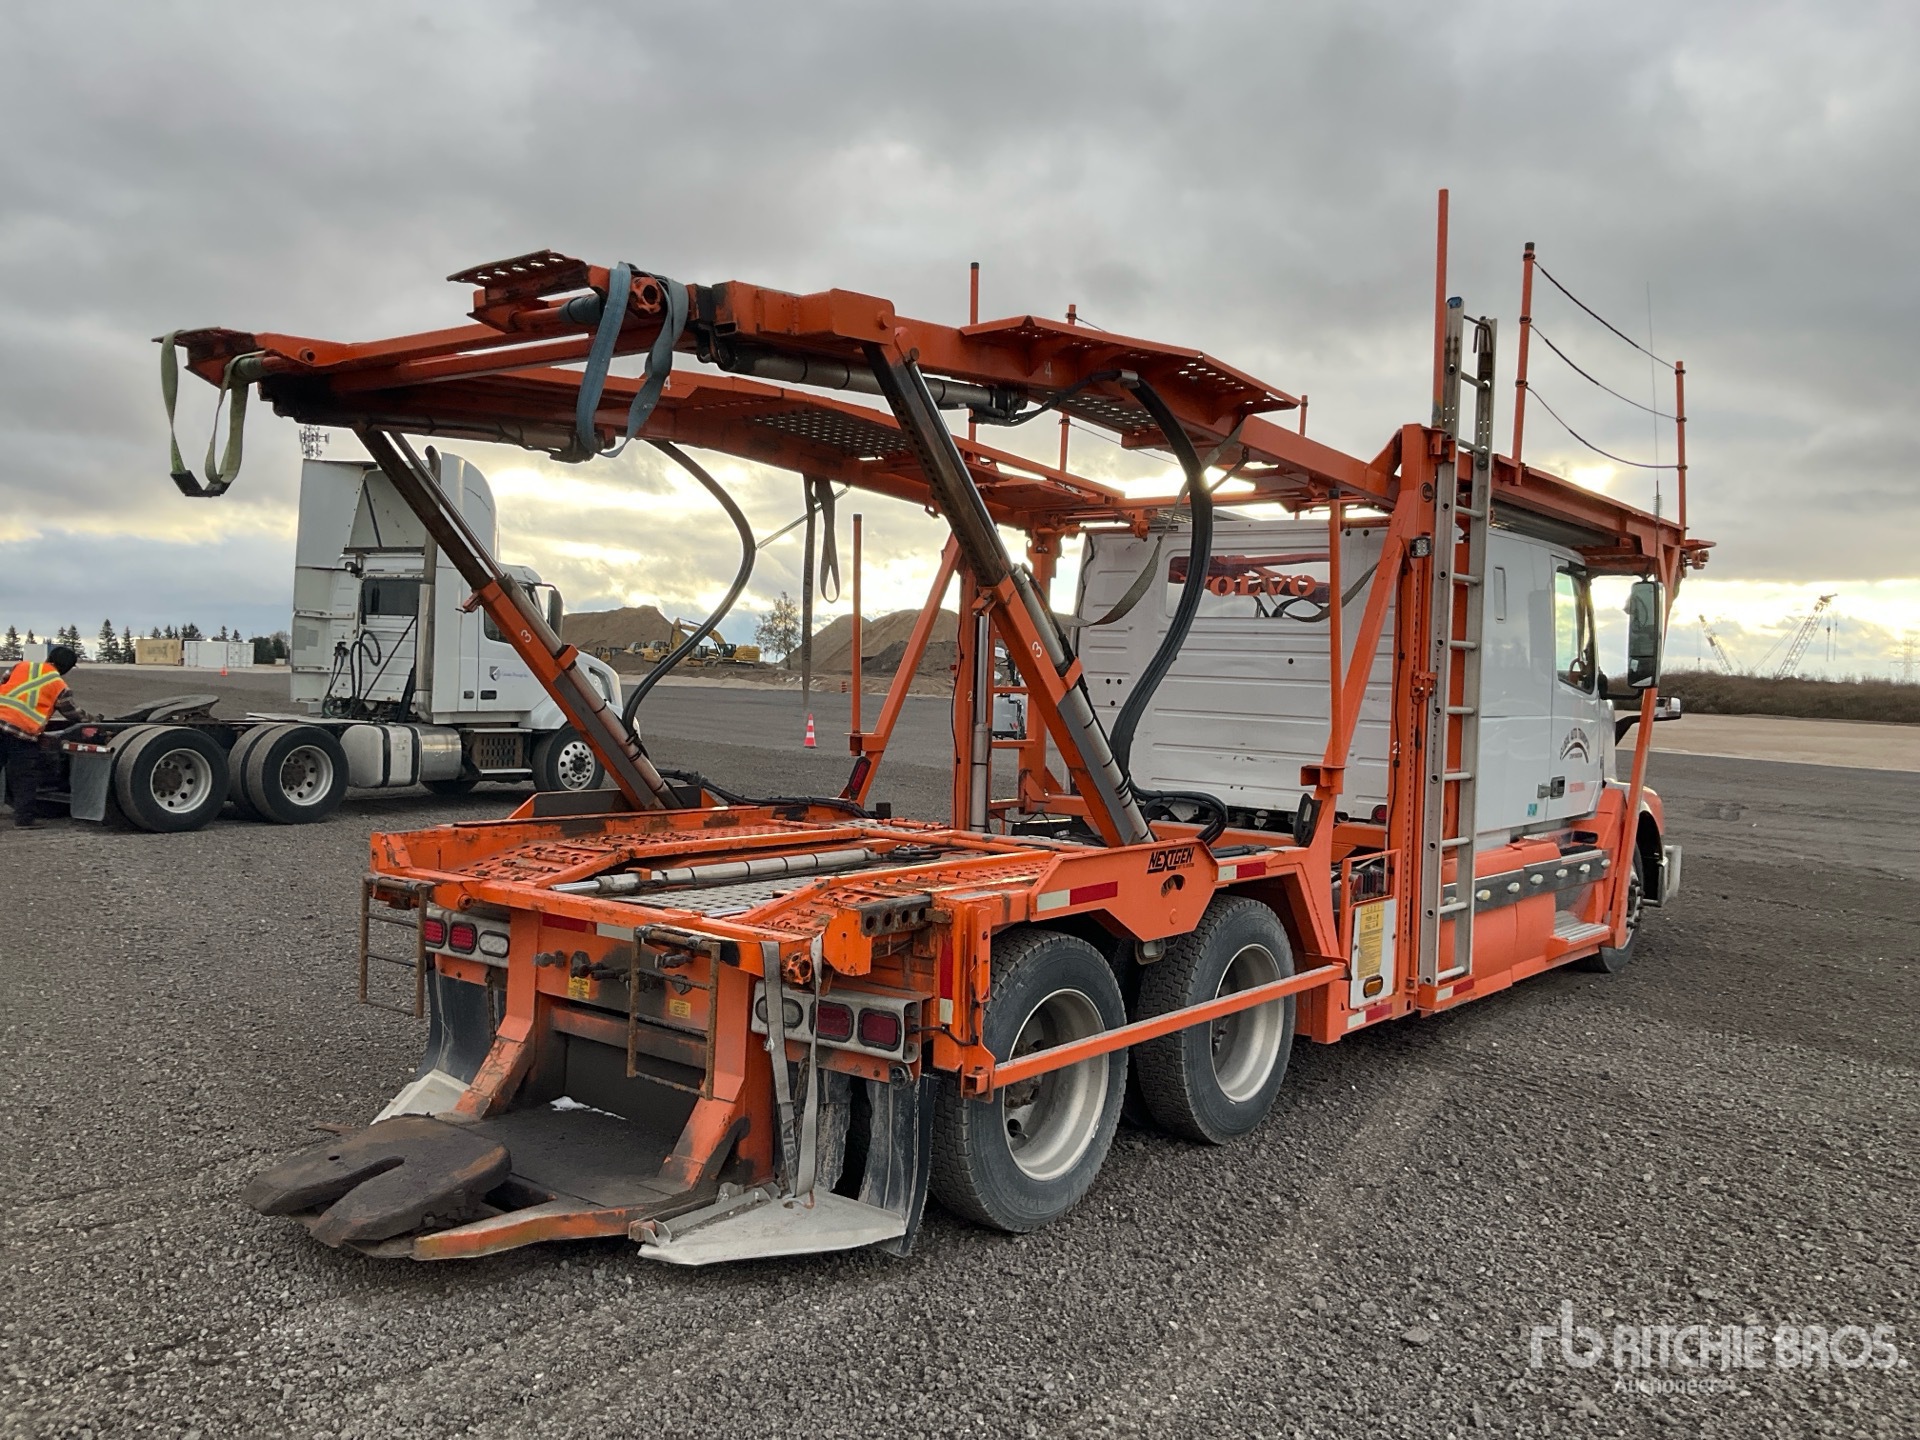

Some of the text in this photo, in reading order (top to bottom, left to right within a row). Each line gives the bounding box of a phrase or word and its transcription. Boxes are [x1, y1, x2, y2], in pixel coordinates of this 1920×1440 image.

[664, 375, 671, 391] 4
[520, 629, 532, 643] 3
[1032, 641, 1043, 658] 3
[967, 690, 973, 702] 2
[1147, 846, 1196, 875] NEXTGEN
